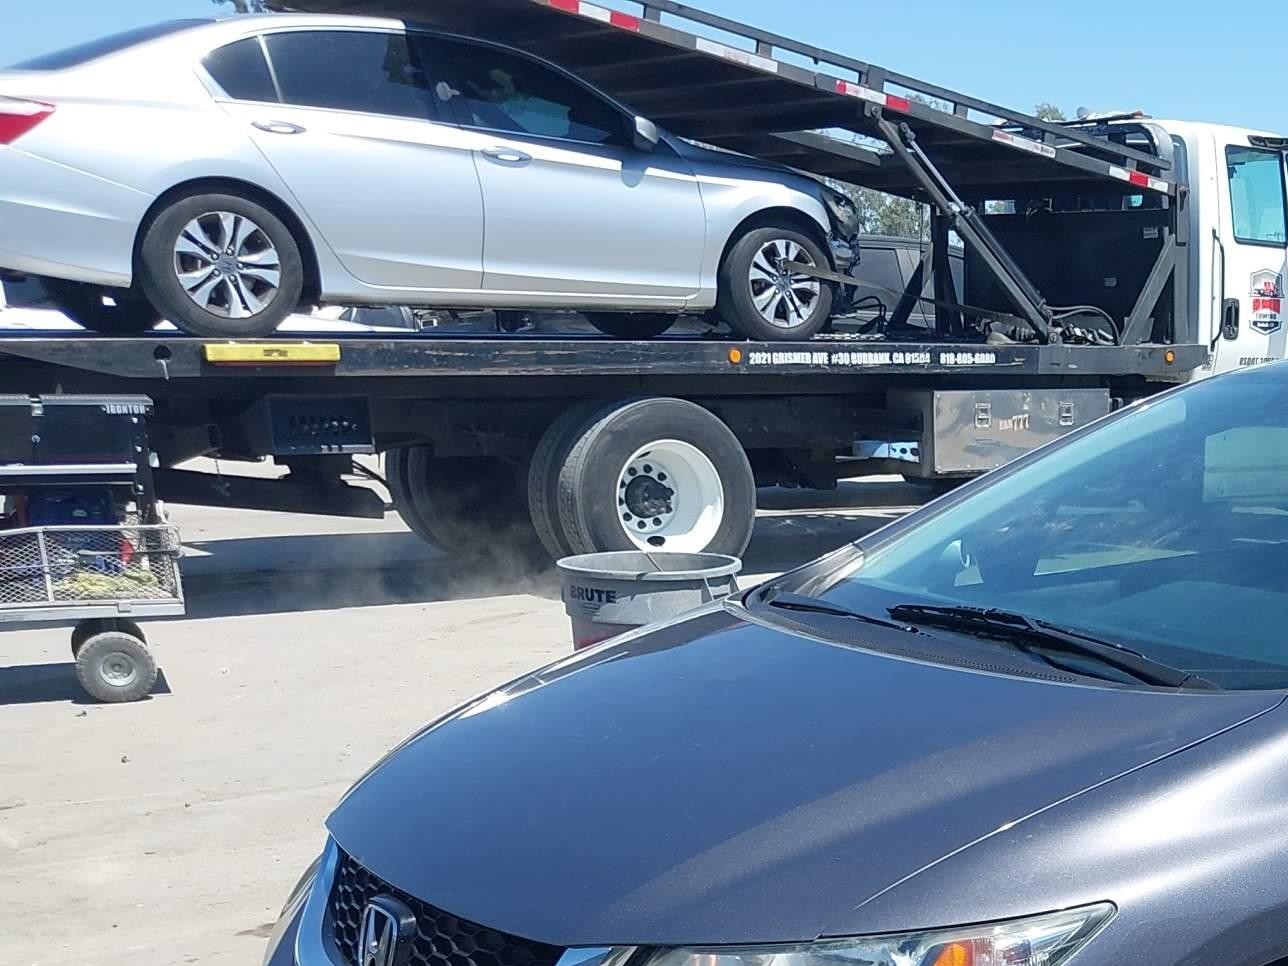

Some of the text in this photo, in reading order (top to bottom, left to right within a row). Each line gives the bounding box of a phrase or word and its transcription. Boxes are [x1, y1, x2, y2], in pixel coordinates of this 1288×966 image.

[749, 352, 771, 365] 2021
[772, 352, 811, 364] GRISMER
[812, 352, 829, 364] AVE
[892, 352, 904, 364] CA
[106, 403, 146, 414] IRONTON
[570, 585, 616, 603] BRUTE
